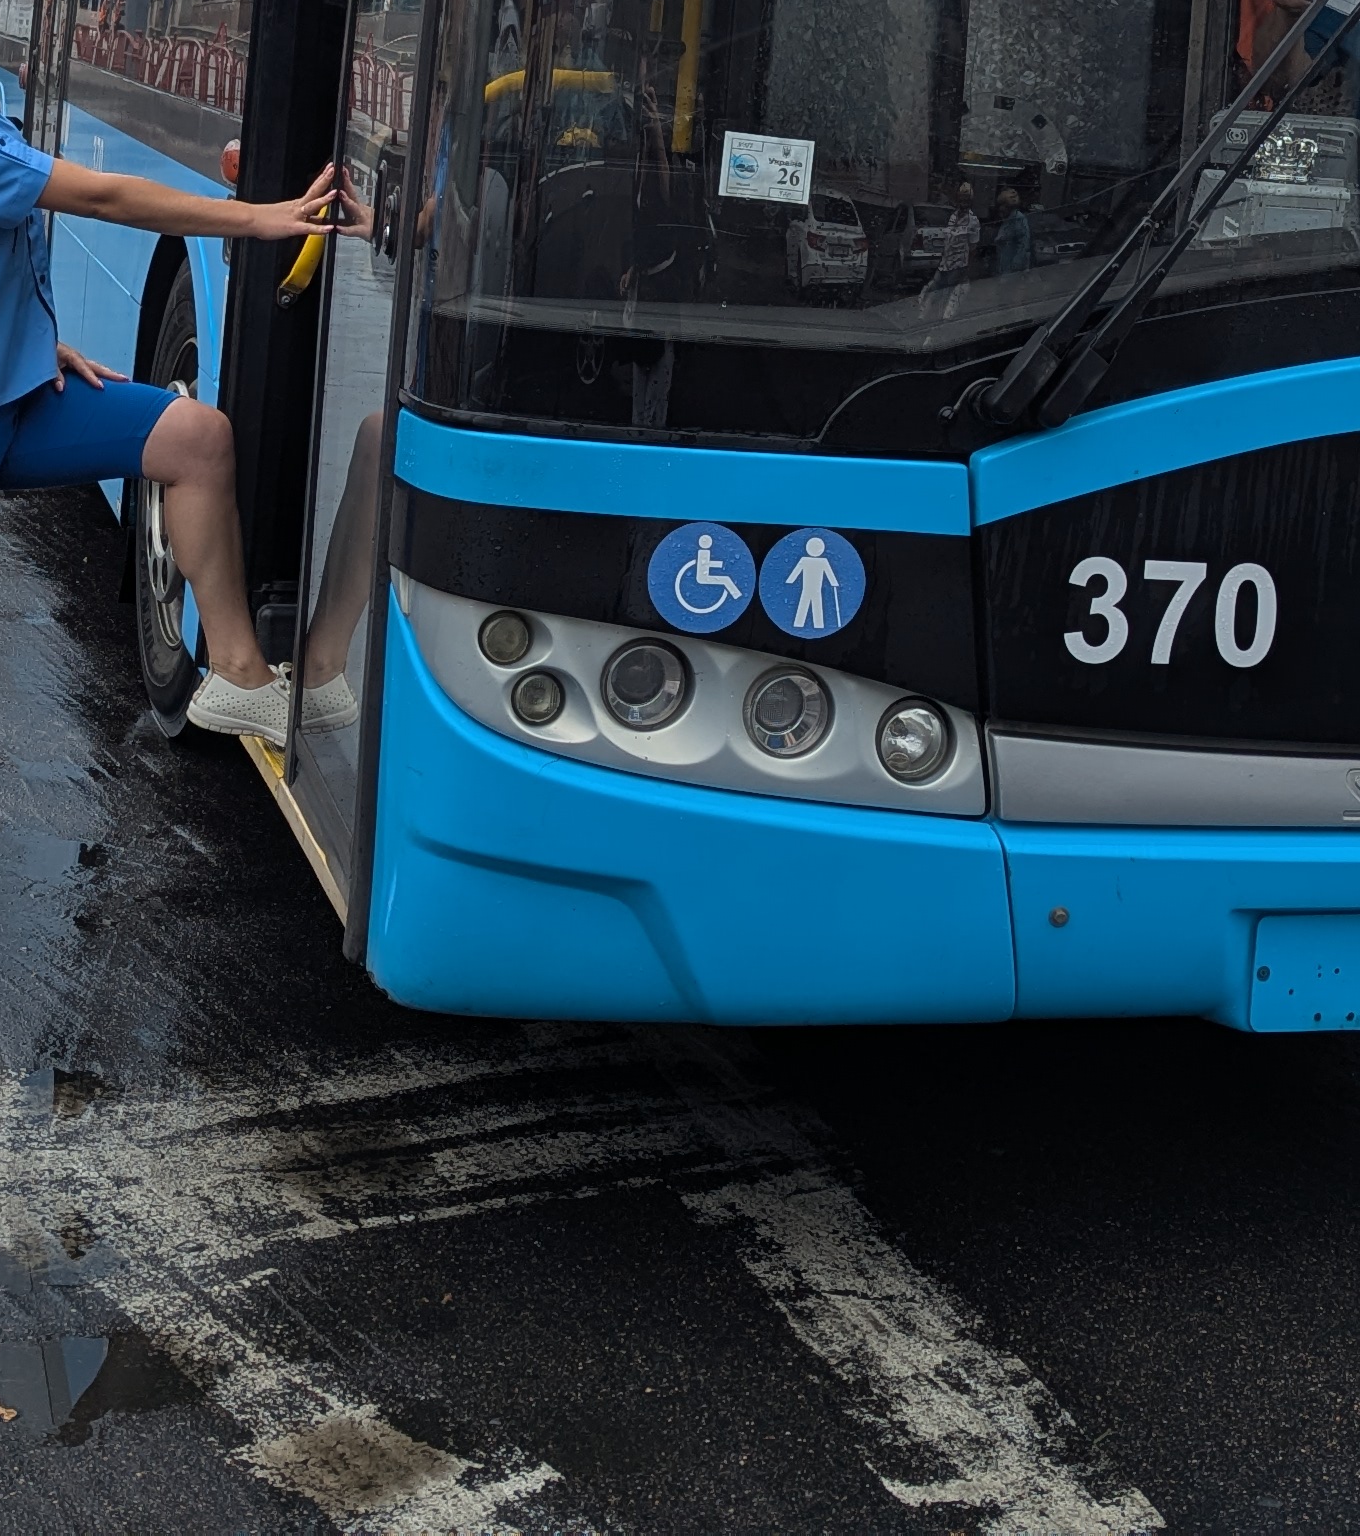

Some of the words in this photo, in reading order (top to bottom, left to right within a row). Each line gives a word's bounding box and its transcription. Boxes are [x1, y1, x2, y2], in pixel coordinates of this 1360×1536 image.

[768, 157, 803, 168] Україна
[777, 167, 801, 186] 26
[1063, 556, 1278, 668] 370
